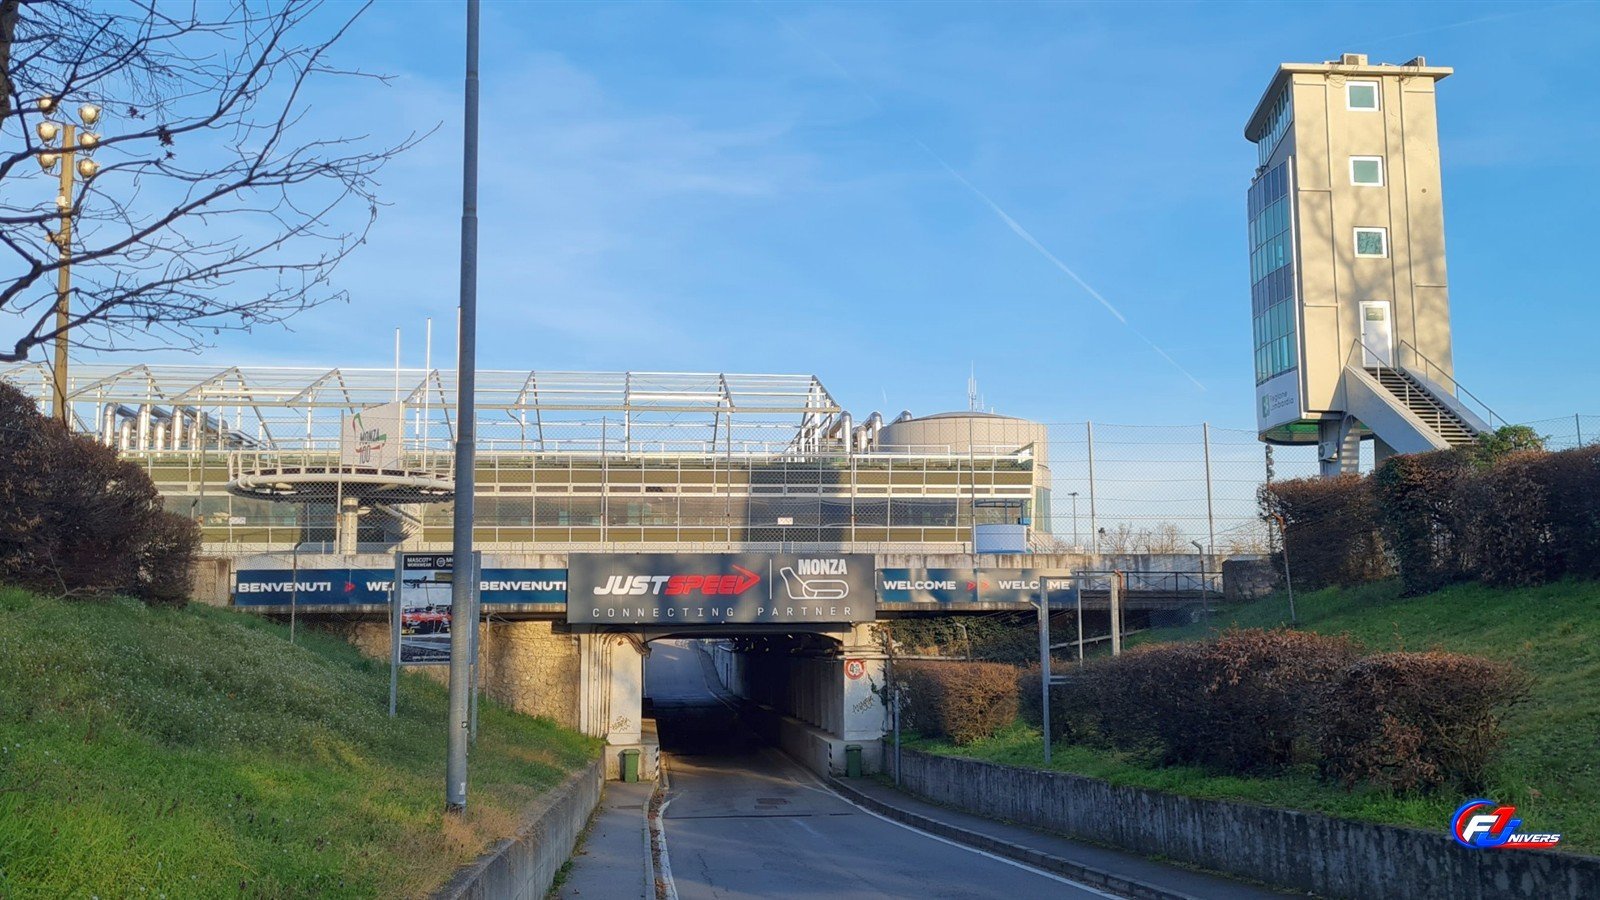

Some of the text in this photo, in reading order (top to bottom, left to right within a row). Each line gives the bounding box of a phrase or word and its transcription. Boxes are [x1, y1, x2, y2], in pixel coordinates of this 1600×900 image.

[798, 559, 848, 575] MONZA
[238, 581, 332, 593] BENVENUTI
[480, 581, 567, 591] BENVENUTI
[883, 580, 957, 590] WELCOME
[998, 580, 1071, 590] WELCME
[592, 607, 852, 618] CONNECTING PARTNER
